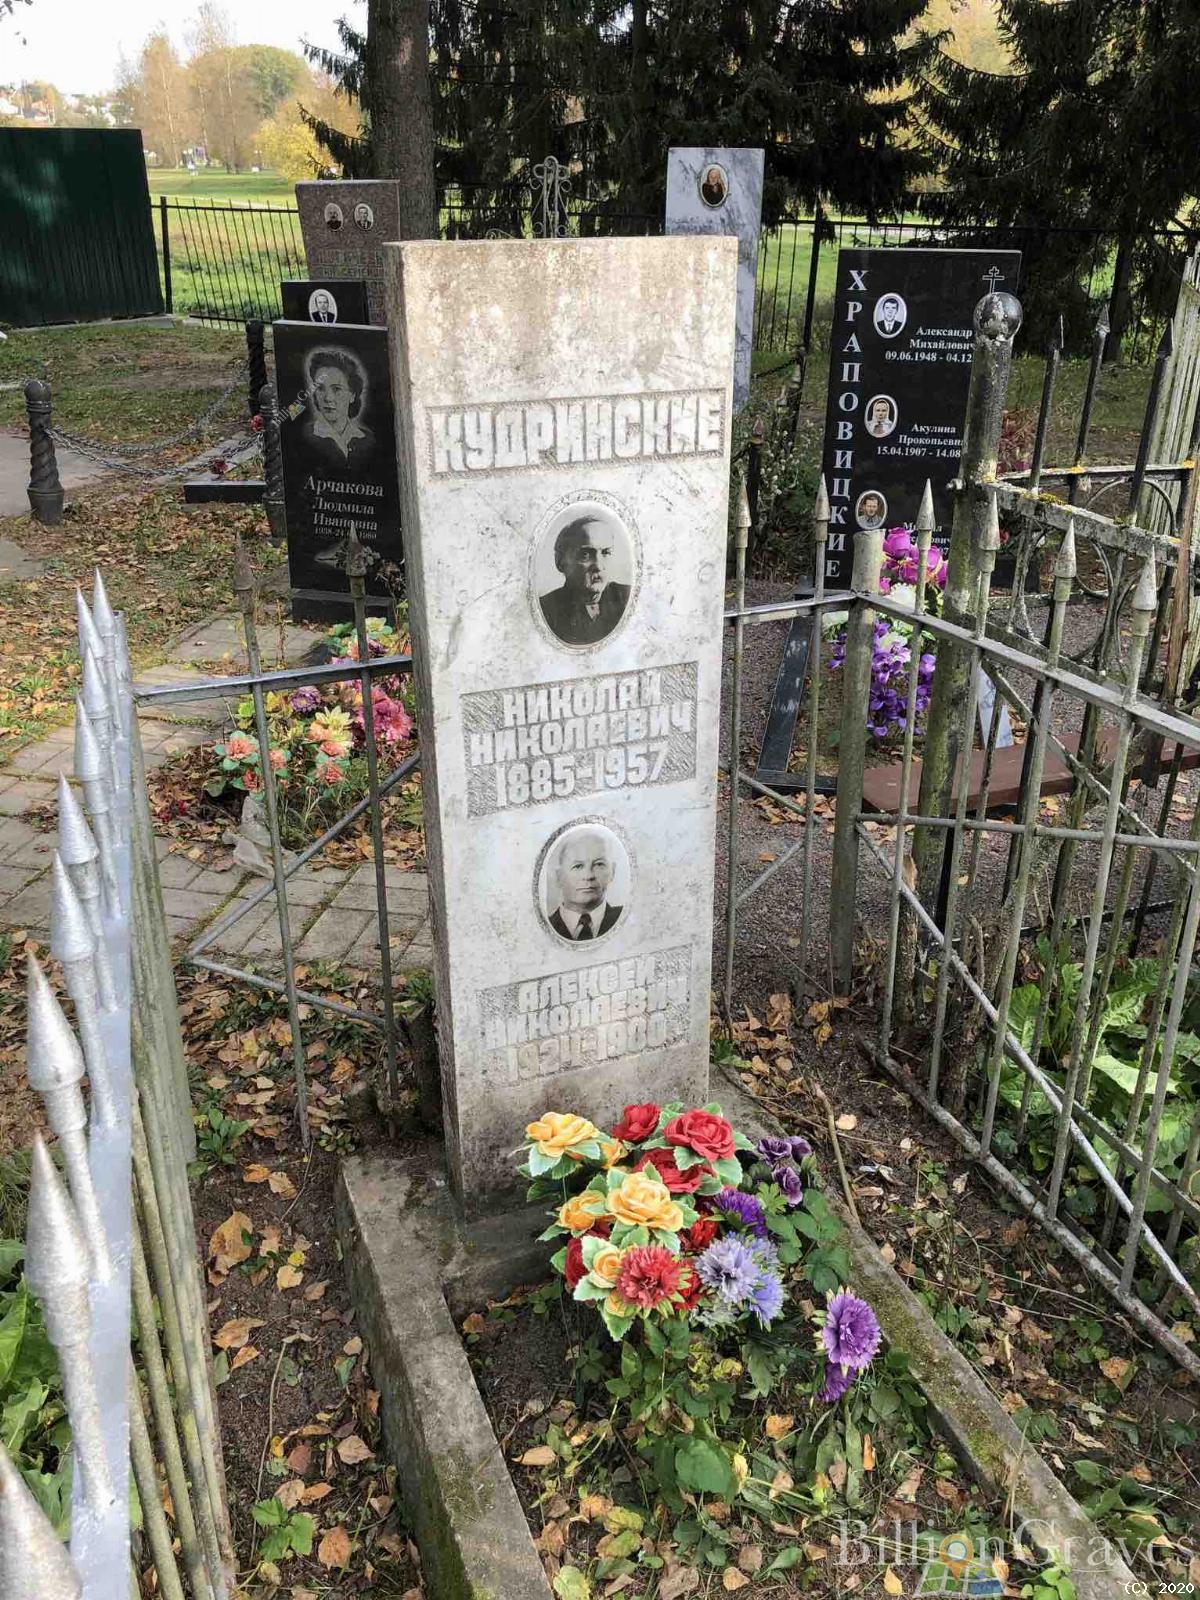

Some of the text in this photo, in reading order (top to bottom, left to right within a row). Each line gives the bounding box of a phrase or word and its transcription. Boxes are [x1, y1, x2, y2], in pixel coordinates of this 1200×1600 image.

[915, 326, 973, 339] Александр
[884, 351, 937, 362] 09.06.1948
[945, 353, 972, 363] 04.12
[824, 269, 869, 578] ХРАПОВИЦКИЕ
[911, 423, 956, 435] Акулина
[430, 395, 721, 474] КУДРИНСКИЕ
[898, 434, 964, 446] Прокопьевн
[877, 446, 927, 456] 15.04.1907
[935, 448, 961, 458] 14.08
[303, 475, 384, 497] Арчакова
[312, 497, 374, 515] Людмила
[502, 671, 663, 729] НИКОЛАЙ
[470, 702, 692, 767] НИКОЛАЕВИЧ
[495, 742, 669, 807] 1885-1957
